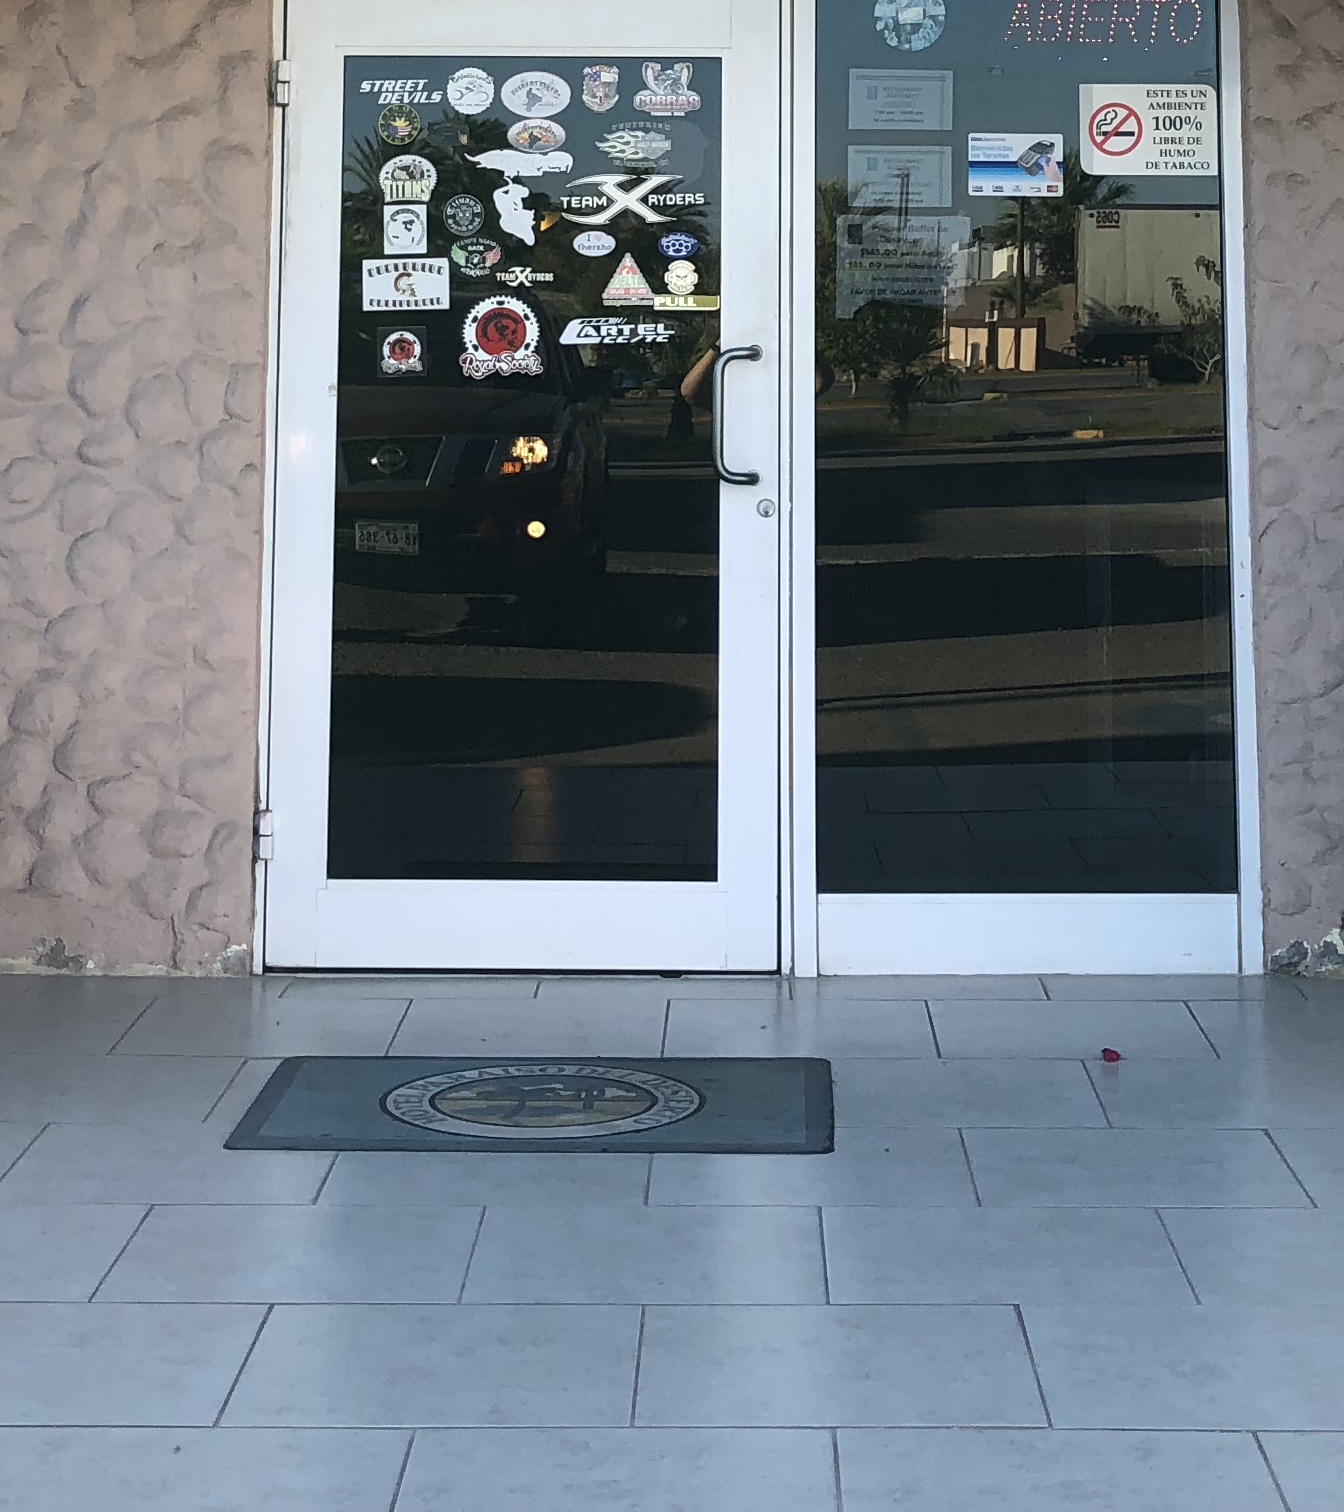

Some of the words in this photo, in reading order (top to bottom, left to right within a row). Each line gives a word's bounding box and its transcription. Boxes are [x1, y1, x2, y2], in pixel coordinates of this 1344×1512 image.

[359, 79, 429, 93] STREET
[377, 90, 444, 104] DEVILS
[1145, 89, 1173, 98] ESTE
[1175, 89, 1188, 98] ES
[1190, 89, 1208, 98] UN
[635, 94, 700, 110] COBRAS
[1147, 101, 1207, 111] AMBIENTE
[1151, 115, 1203, 132] 100%
[1152, 136, 1185, 146] LIBRE
[1186, 136, 1203, 146] DE
[1158, 148, 1196, 158] HUMO
[1144, 160, 1162, 170] DE
[1162, 160, 1211, 170] TABACO
[559, 195, 608, 209] TEAM
[647, 193, 705, 207] RYDERS
[655, 296, 698, 307] PULL
[559, 317, 676, 345] CARTEL
